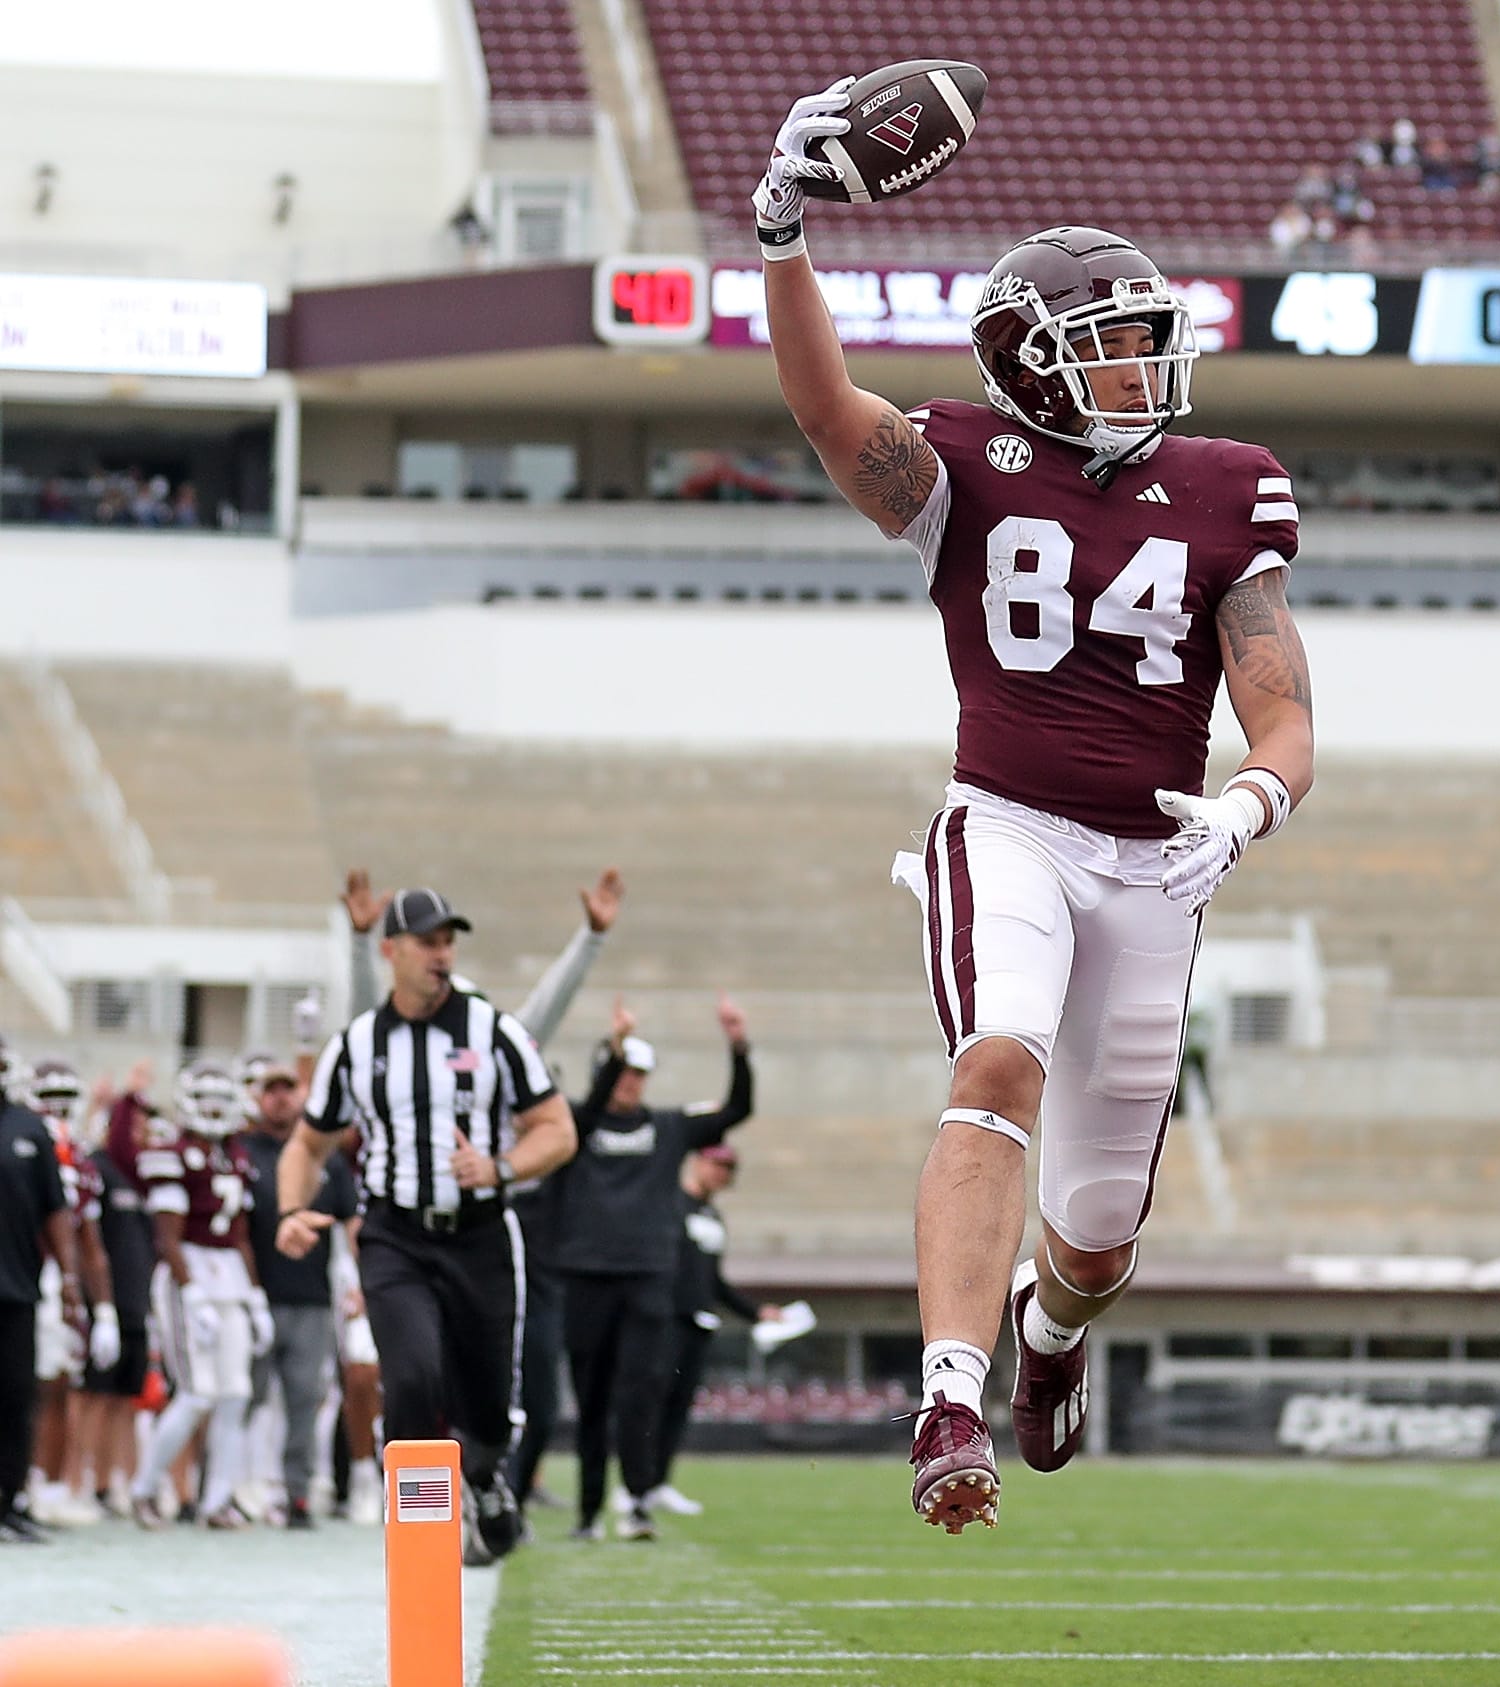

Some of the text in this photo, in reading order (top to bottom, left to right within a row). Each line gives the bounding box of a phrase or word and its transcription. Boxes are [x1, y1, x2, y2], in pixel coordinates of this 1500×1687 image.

[860, 85, 902, 118] DIME
[613, 268, 694, 327] 40
[1271, 273, 1379, 355] 45
[990, 437, 1029, 470] SEC
[983, 516, 1193, 685] 84
[211, 1173, 244, 1237] 7
